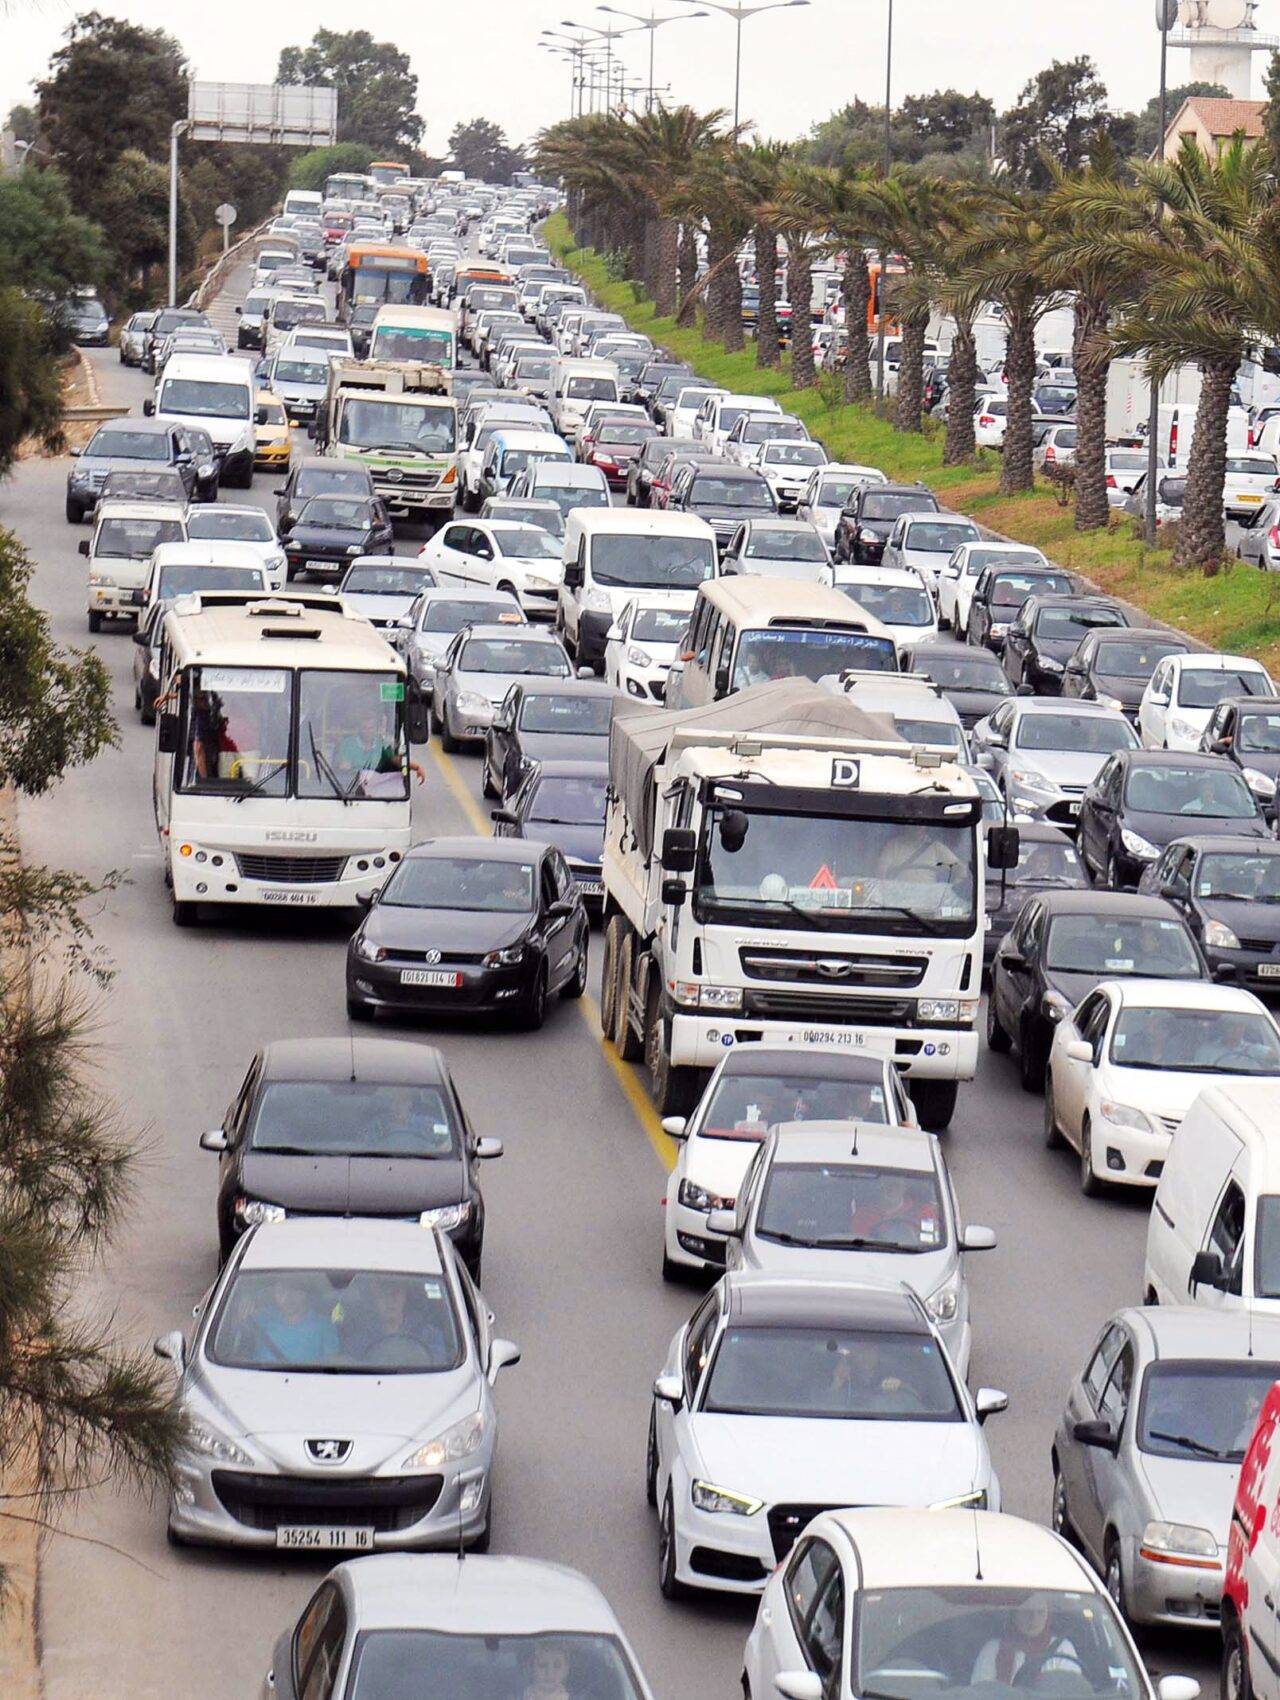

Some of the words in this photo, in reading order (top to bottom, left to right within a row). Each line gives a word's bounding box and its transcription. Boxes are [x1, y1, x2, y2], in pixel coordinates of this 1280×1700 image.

[834, 760, 858, 786] D
[265, 831, 318, 842] ISUZU
[284, 1529, 320, 1545] 35254
[330, 1530, 345, 1545] 111
[356, 1530, 367, 1546] 16
